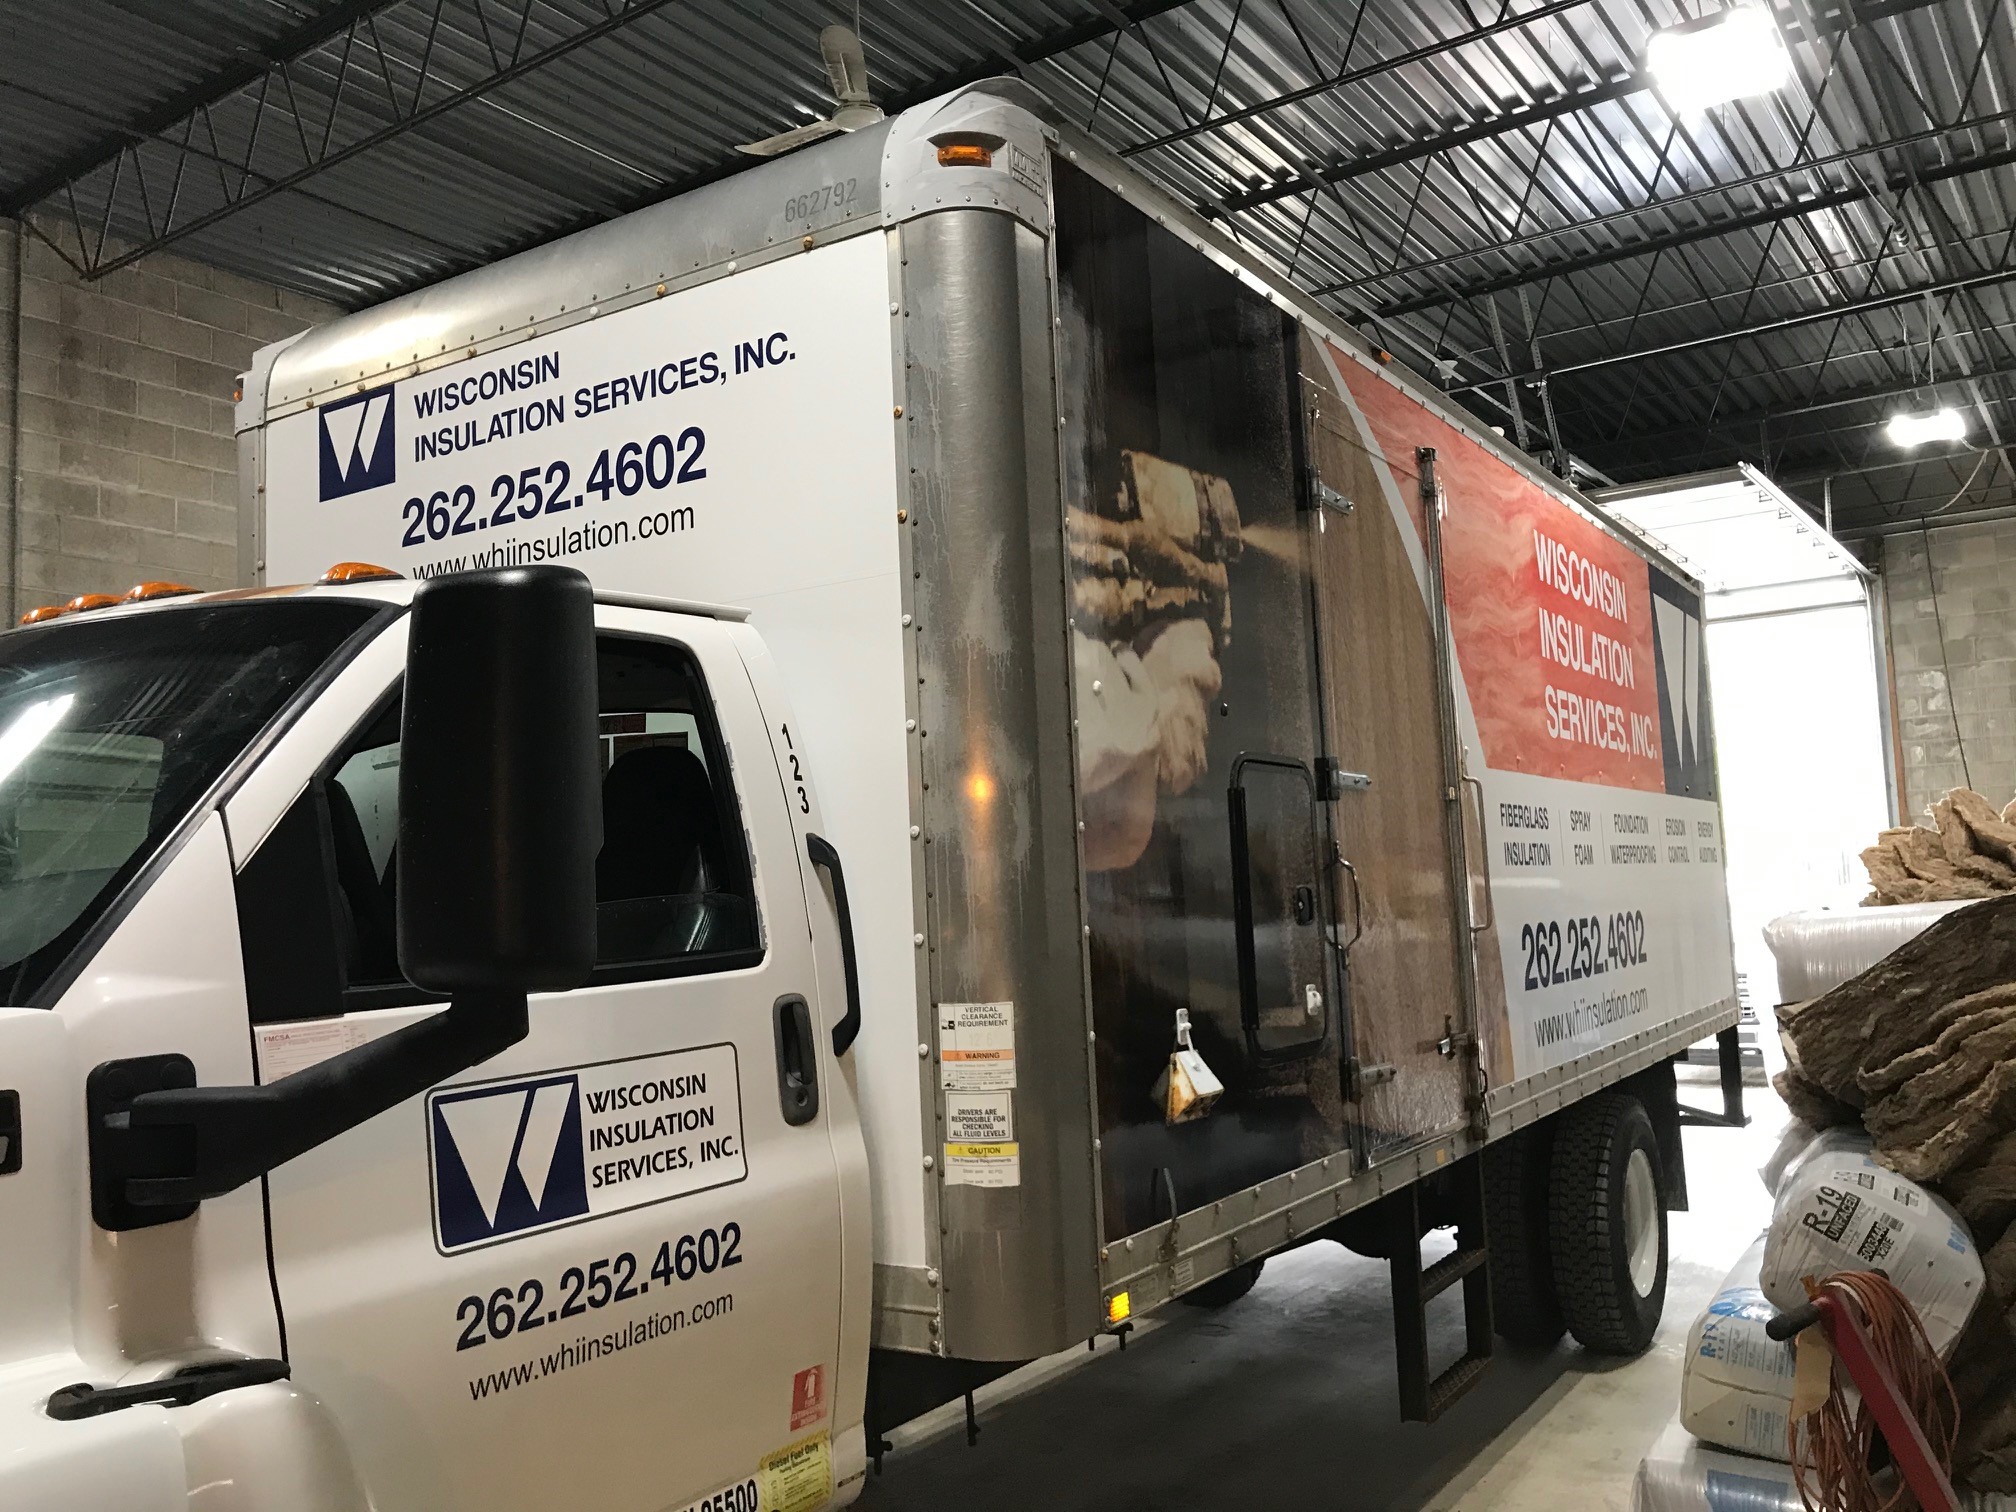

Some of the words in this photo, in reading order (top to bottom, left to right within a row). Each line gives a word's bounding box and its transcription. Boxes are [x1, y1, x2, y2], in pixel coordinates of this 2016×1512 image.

[785, 178, 857, 222] 662792
[414, 351, 561, 419] WISCONSIN
[414, 400, 565, 462] INSULATION
[575, 351, 727, 418] SERVICES,
[734, 331, 797, 376] INC.
[401, 426, 707, 548] 262.252.4602
[412, 505, 695, 580] wwwwhiinsulation.com
[1533, 529, 1628, 624] WISCONSIN
[1538, 606, 1635, 690] INSULATION
[1544, 684, 1631, 762] SERVICES,
[1630, 714, 1658, 759] INC.
[1500, 802, 1549, 830] FIBERGLASS
[1570, 810, 1591, 832] SPRAY
[1613, 813, 1649, 834] FOUNDATION
[1665, 818, 1686, 836] EROSION
[1504, 841, 1551, 866] INSULATION
[1574, 844, 1594, 865] FOAM
[1609, 844, 1657, 864] WATERPROOFING
[1667, 846, 1690, 863] CONTROL
[1521, 909, 1648, 992] 262.252.4602
[263, 1034, 290, 1042] FMCSA
[957, 1019, 1008, 1027] REQUIREMENT
[1533, 987, 1649, 1048] www.whiinsulation.com
[586, 1072, 706, 1114] WISCONSIN
[957, 1108, 983, 1116] DRIVERS
[589, 1106, 714, 1152] INSULATION
[951, 1115, 991, 1123] RESPONSIBLE
[592, 1146, 694, 1189] SERVICES,
[700, 1135, 739, 1163] INC.
[1802, 1186, 1844, 1235] R-19
[1825, 1193, 1859, 1240] UNFACED
[456, 1221, 743, 1352] 262.252.4602
[469, 1293, 734, 1401] www.whiinsulation.com
[769, 1454, 789, 1471] Diesel
